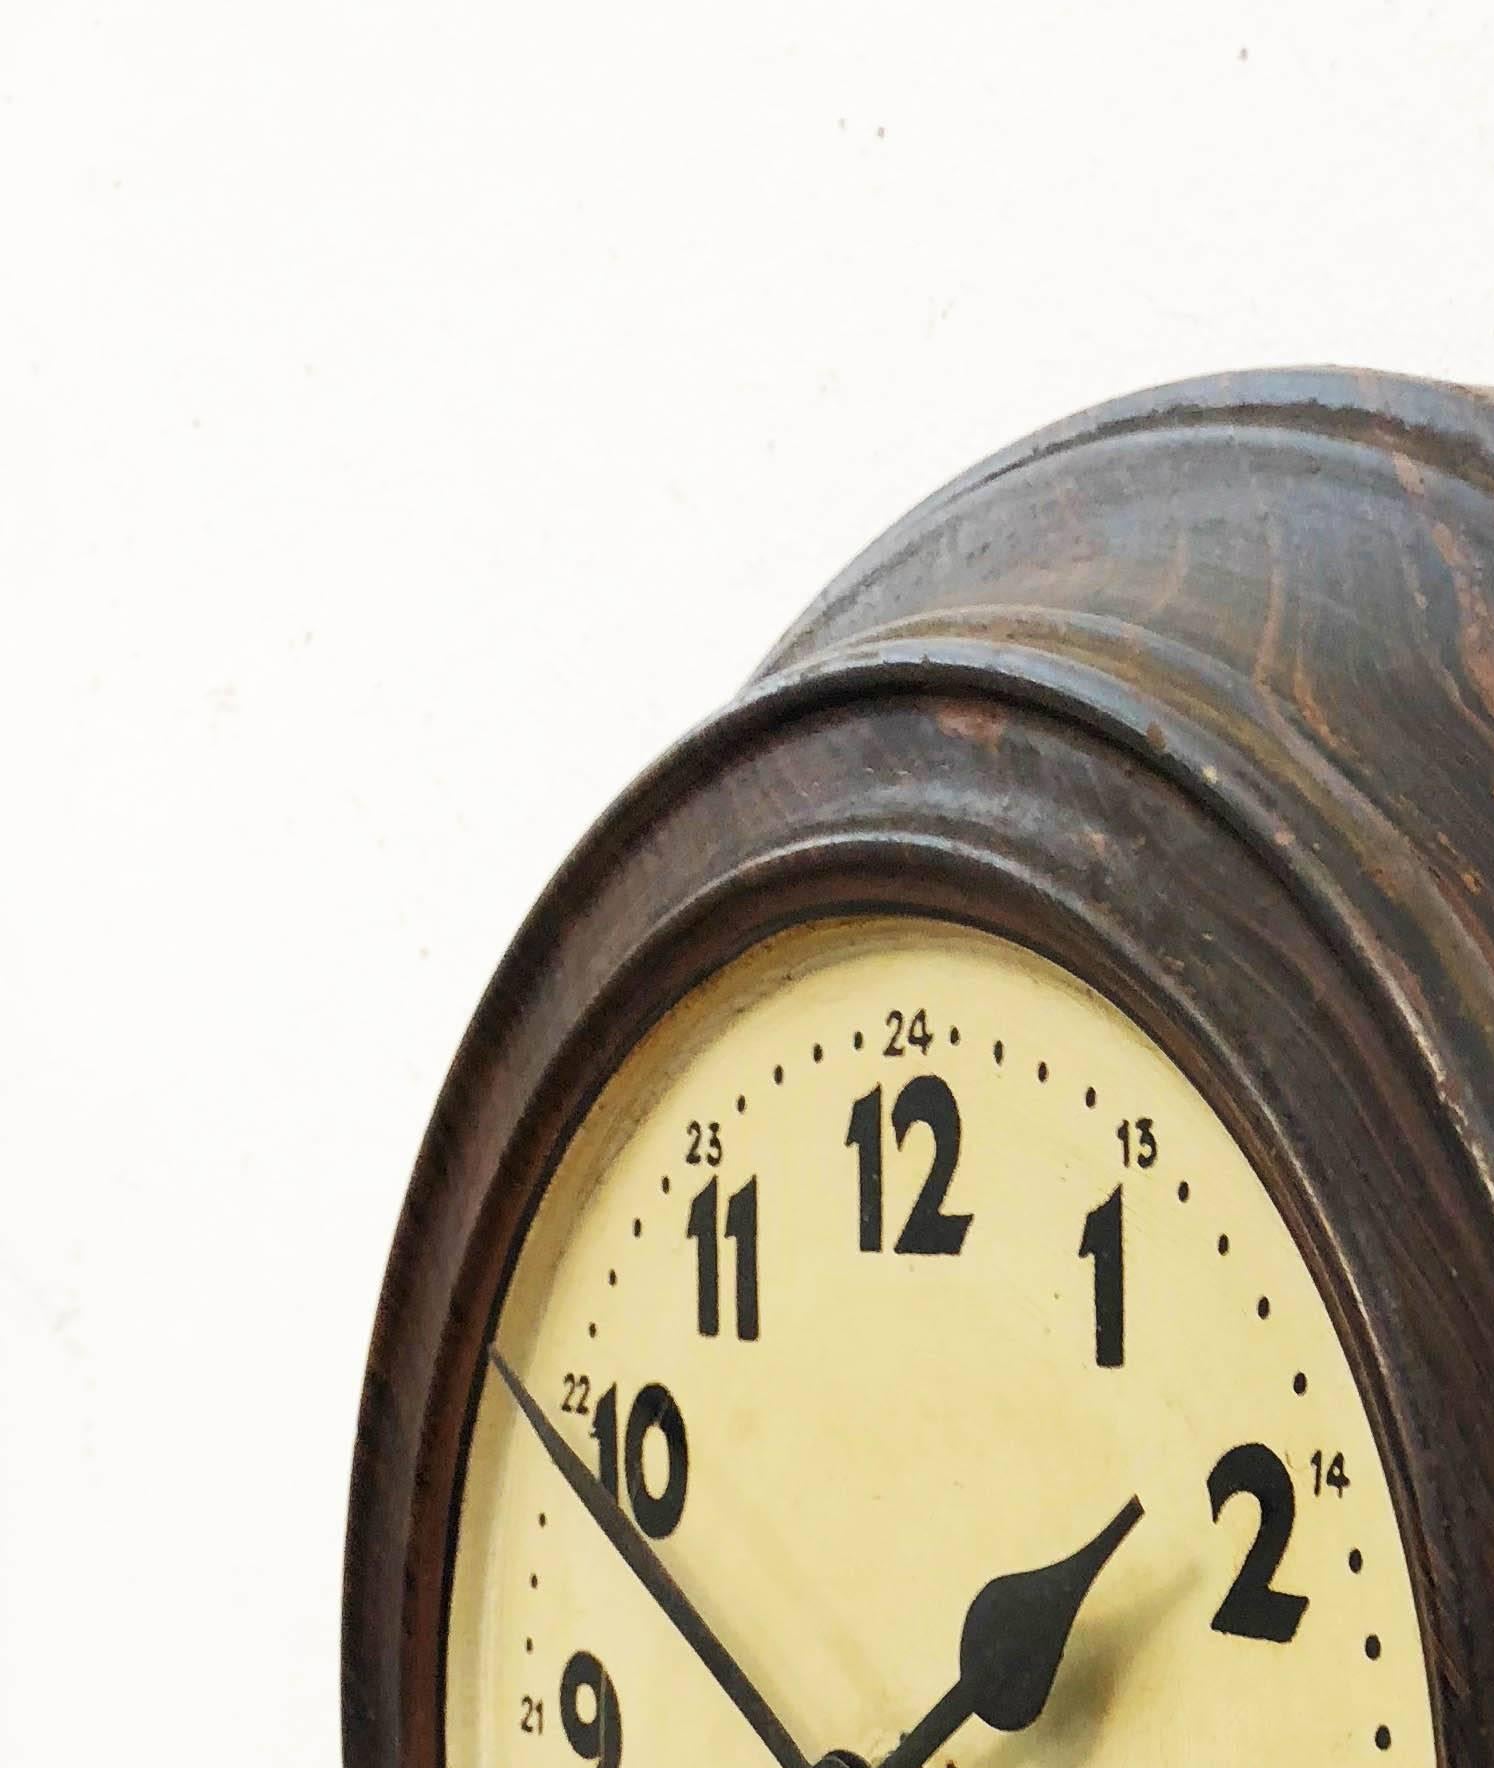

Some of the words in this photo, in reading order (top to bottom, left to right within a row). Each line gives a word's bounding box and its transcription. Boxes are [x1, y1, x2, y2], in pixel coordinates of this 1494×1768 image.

[883, 1009, 933, 1057] 24
[685, 1120, 723, 1167] 23
[845, 1074, 975, 1257] 12
[1116, 1117, 1158, 1169] 13
[686, 1174, 761, 1342] 11
[1078, 1183, 1126, 1369] 1
[560, 1373, 591, 1416] 22
[588, 1381, 690, 1541] 10
[1310, 1450, 1350, 1498] 14
[1206, 1442, 1310, 1644] 2
[520, 1695, 544, 1735] 21
